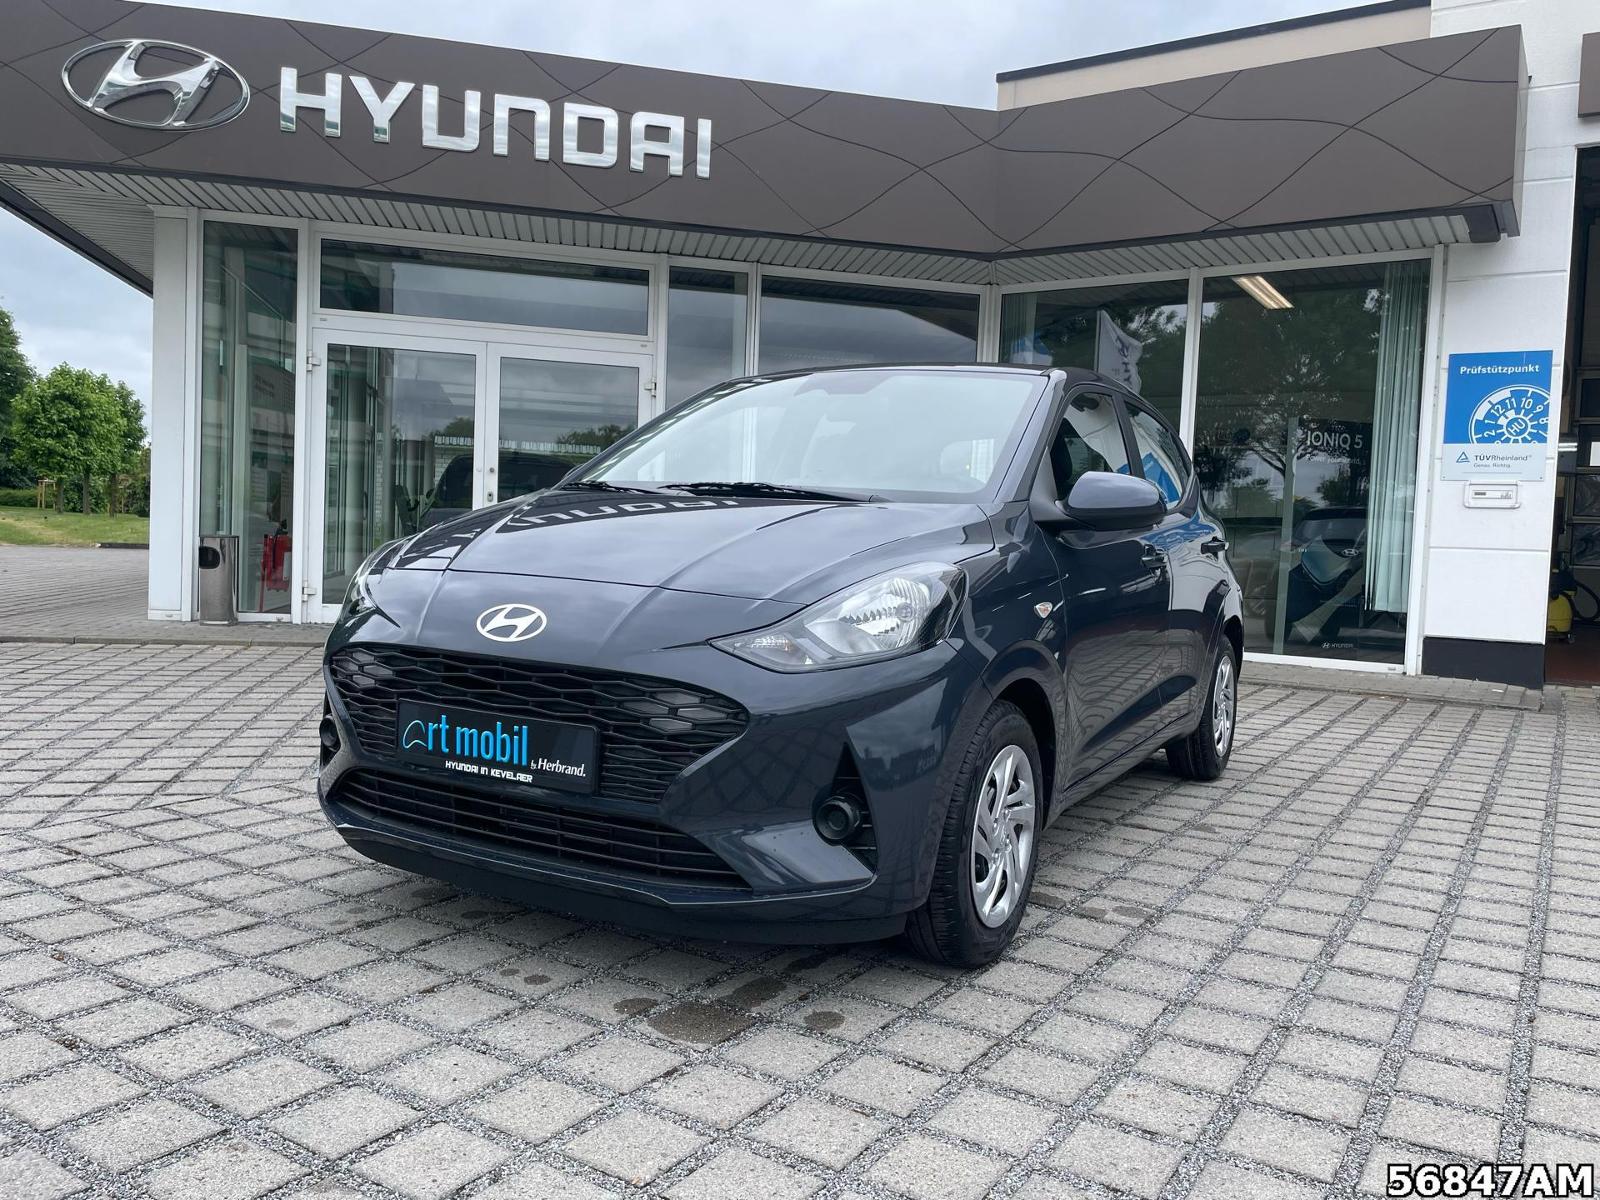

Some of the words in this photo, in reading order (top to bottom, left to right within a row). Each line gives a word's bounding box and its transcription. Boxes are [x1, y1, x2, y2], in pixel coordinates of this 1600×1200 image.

[280, 66, 711, 179] HYUNDAI
[1460, 364, 1539, 376] Prüfstützpunkt
[1491, 404, 1506, 417] 12
[1505, 398, 1516, 408] 11
[1520, 397, 1533, 408] 10
[1507, 419, 1526, 435] HU
[1307, 430, 1350, 450] IONIQ
[1353, 434, 1363, 449] 5
[456, 722, 529, 766] mobil
[445, 760, 478, 774] HYUNDAI
[490, 769, 533, 783] KEVELAER
[537, 758, 586, 777] Herbrand.
